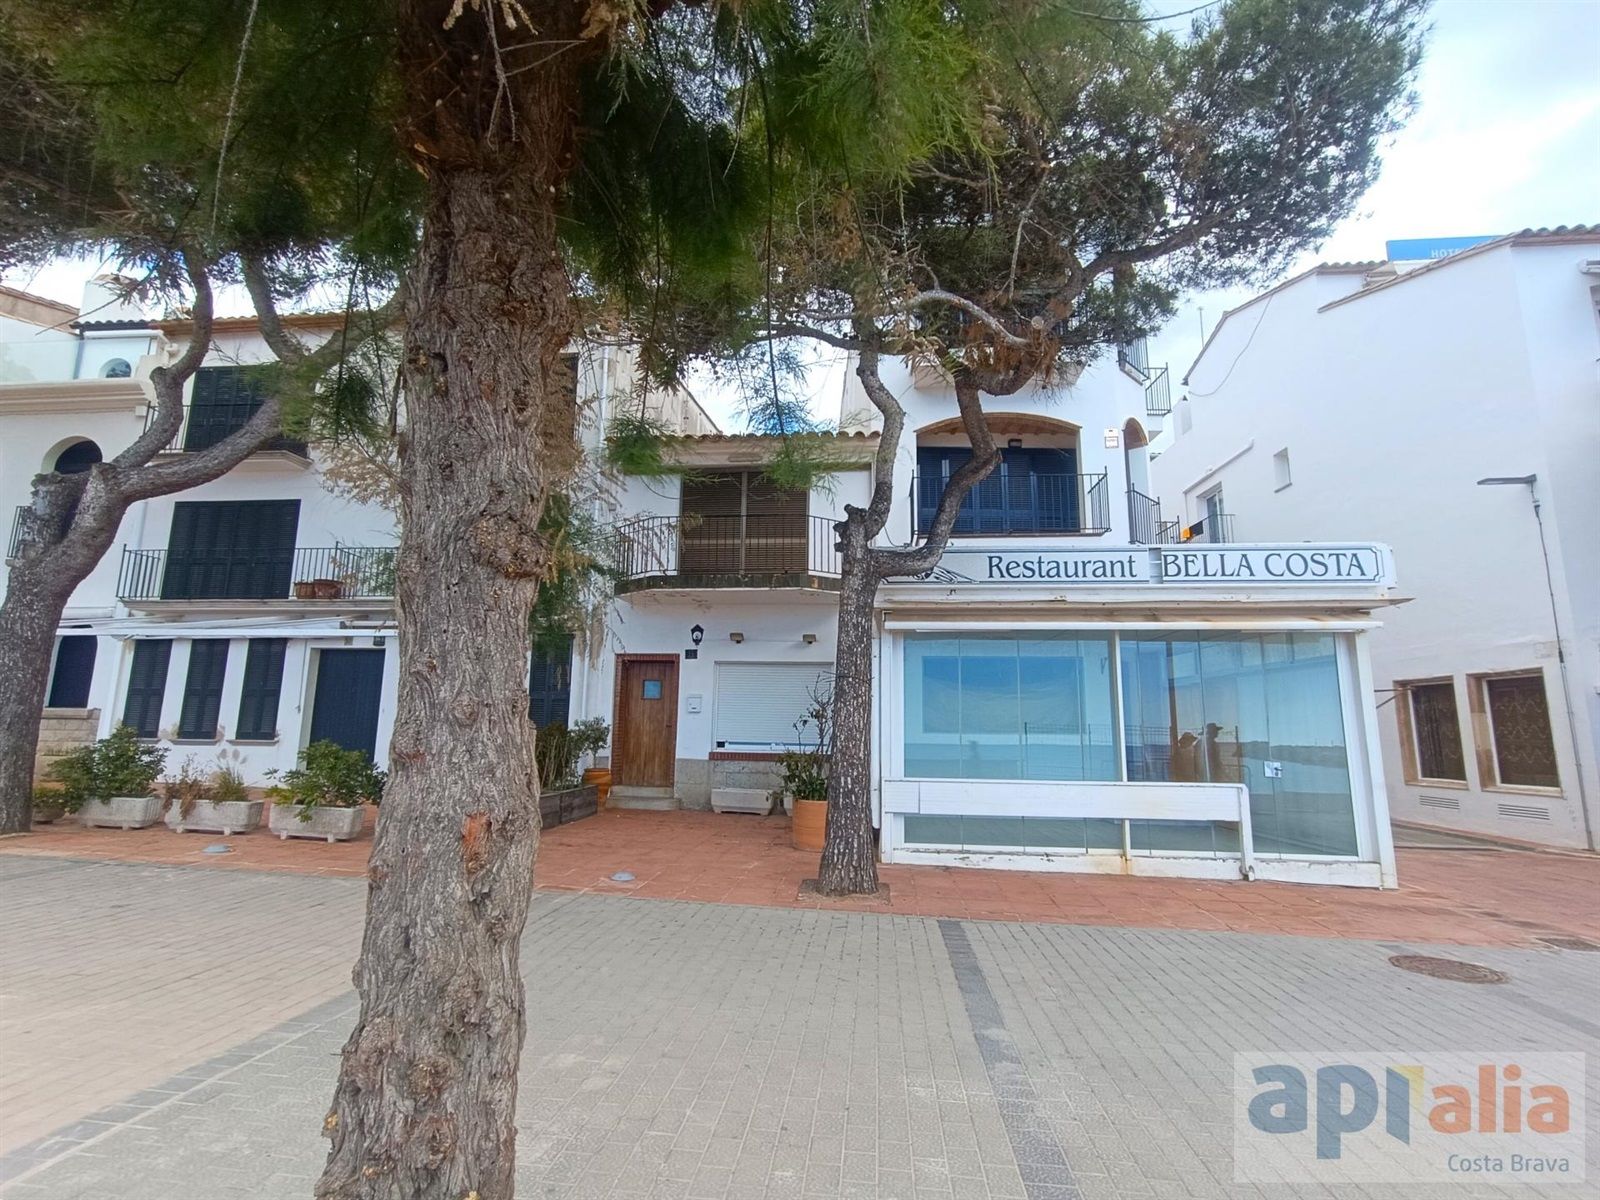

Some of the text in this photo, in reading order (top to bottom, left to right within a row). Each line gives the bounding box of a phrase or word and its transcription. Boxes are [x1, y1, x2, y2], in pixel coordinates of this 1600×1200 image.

[987, 552, 1367, 579] Restaurant BELLA COSTA
